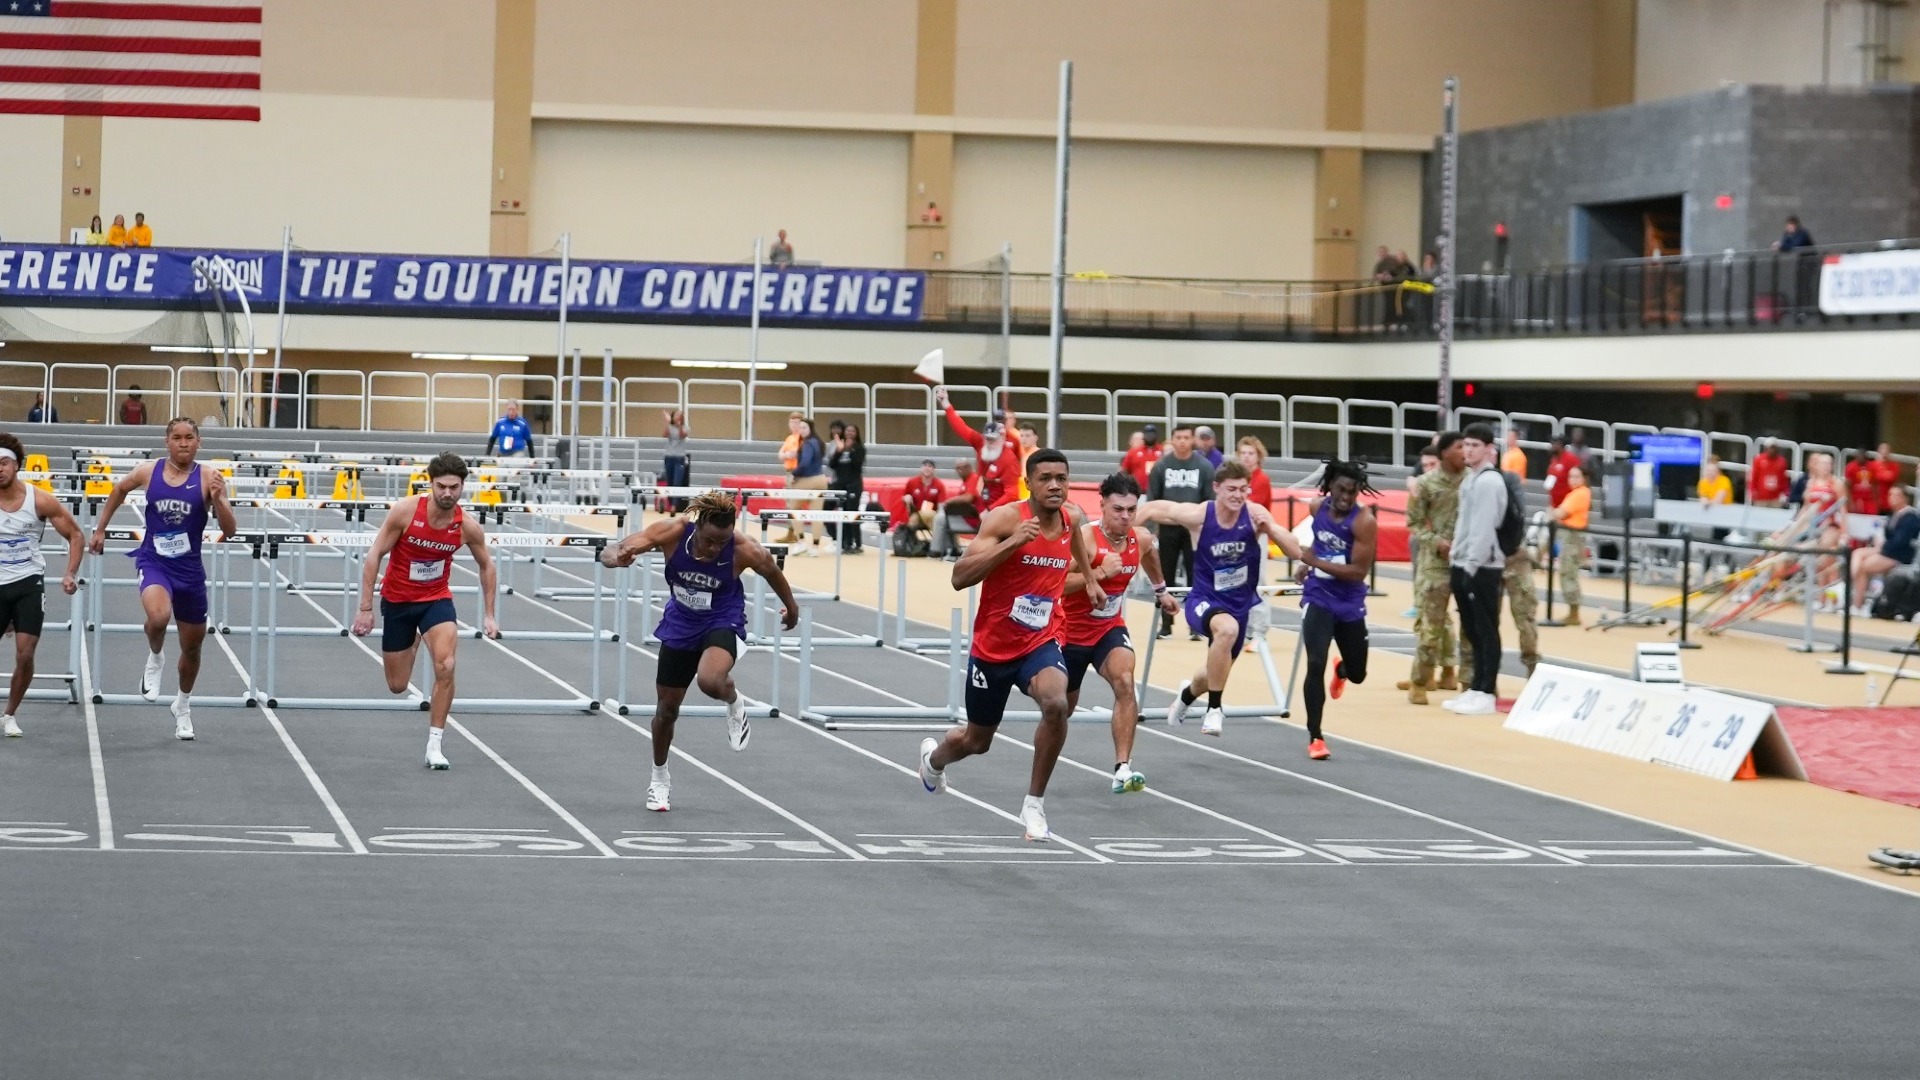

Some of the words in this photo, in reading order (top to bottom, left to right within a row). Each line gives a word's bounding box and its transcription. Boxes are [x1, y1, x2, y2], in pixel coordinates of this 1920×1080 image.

[299, 257, 378, 300] THE
[393, 261, 625, 307] SOUTHERN
[641, 268, 919, 316] CONFERENCE
[1165, 468, 1200, 489] SOCON
[155, 499, 192, 515] WCU
[159, 540, 185, 549] ROBERTS
[333, 536, 373, 546] KEYDETS
[503, 537, 543, 546] KEYDETS
[407, 536, 457, 552] SAMFORD
[1210, 543, 1247, 557] WCU
[416, 566, 438, 575] WRIGHT
[678, 571, 722, 589] WCU
[1017, 604, 1047, 618] FRANKLIN
[1642, 663, 1678, 671] UCS
[974, 669, 984, 686] 4
[1531, 680, 1557, 711] 17
[1572, 687, 1601, 722] 20
[1616, 697, 1647, 733] 23
[1666, 703, 1698, 739] 26
[1712, 713, 1746, 750] 29
[123, 830, 344, 849] 7
[368, 833, 585, 850] 6
[612, 836, 838, 854] 5
[856, 838, 1075, 856] 4
[1094, 842, 1306, 858] 3
[1311, 844, 1534, 860] 2
[1540, 844, 1757, 859] 1
